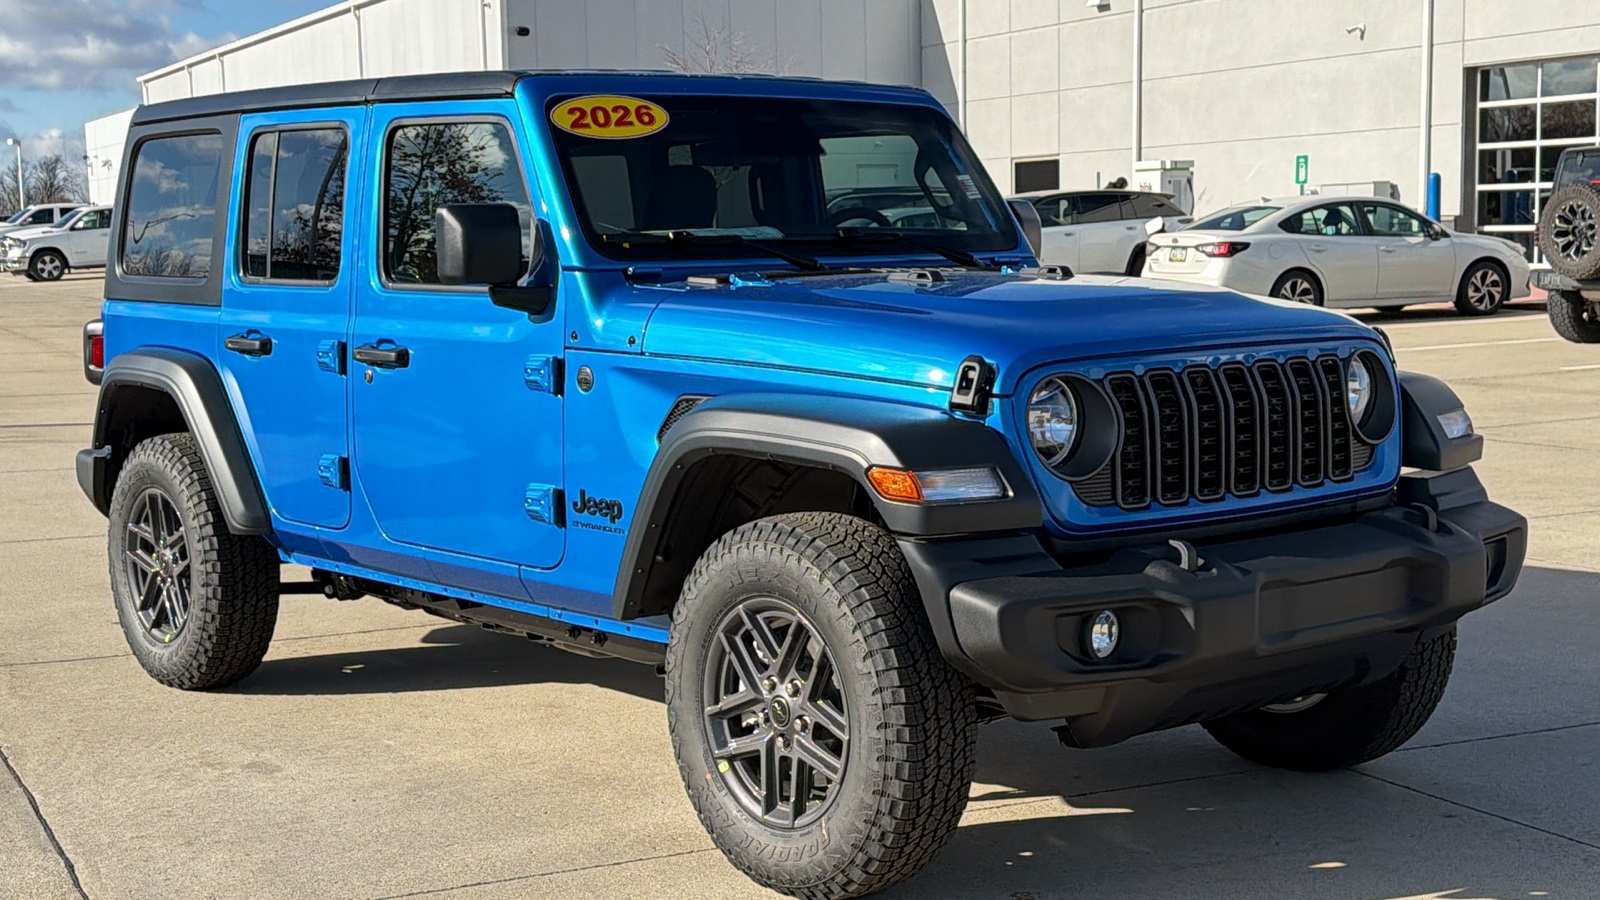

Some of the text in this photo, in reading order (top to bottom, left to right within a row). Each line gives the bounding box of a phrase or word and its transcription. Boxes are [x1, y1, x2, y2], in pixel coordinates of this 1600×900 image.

[567, 104, 656, 129] 2026
[572, 488, 623, 524] Jeep
[580, 521, 625, 535] WRANGLER
